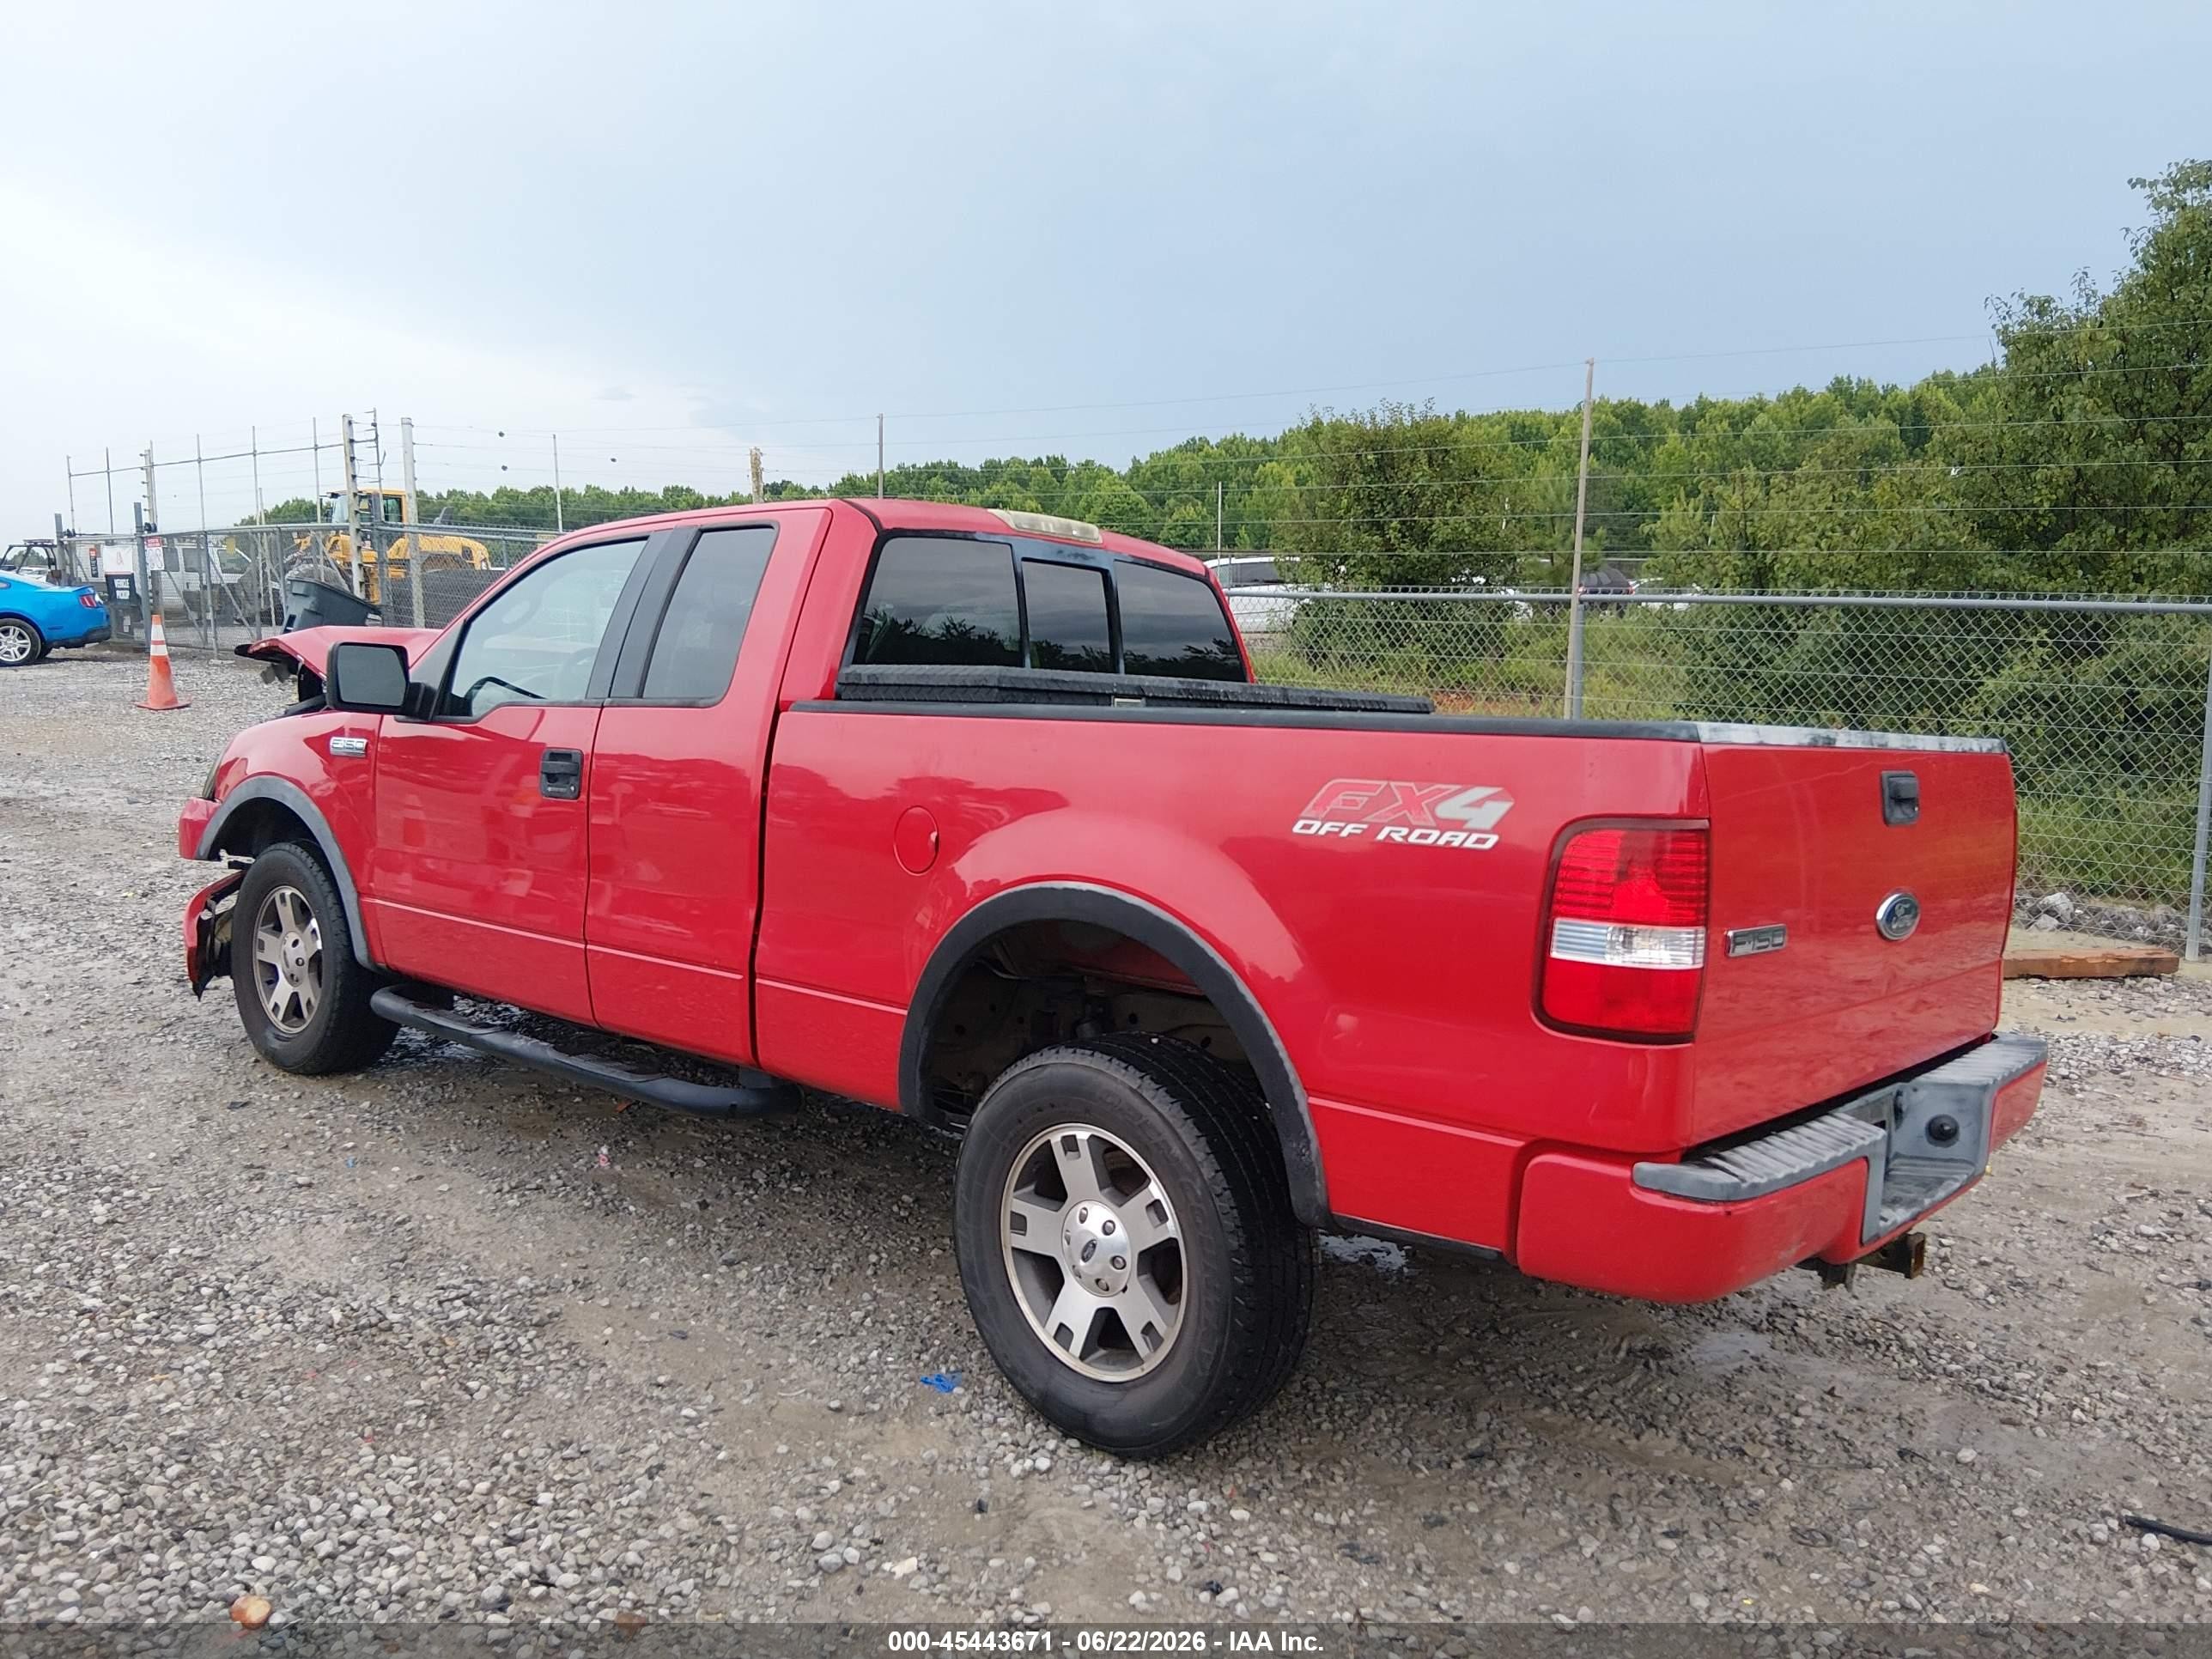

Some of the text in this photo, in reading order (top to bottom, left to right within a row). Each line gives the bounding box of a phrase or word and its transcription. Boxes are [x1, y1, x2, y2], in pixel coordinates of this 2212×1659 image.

[1300, 778, 1515, 830] FX4
[1292, 819, 1500, 849] OFF ROAD
[1732, 928, 1785, 953] F-150
